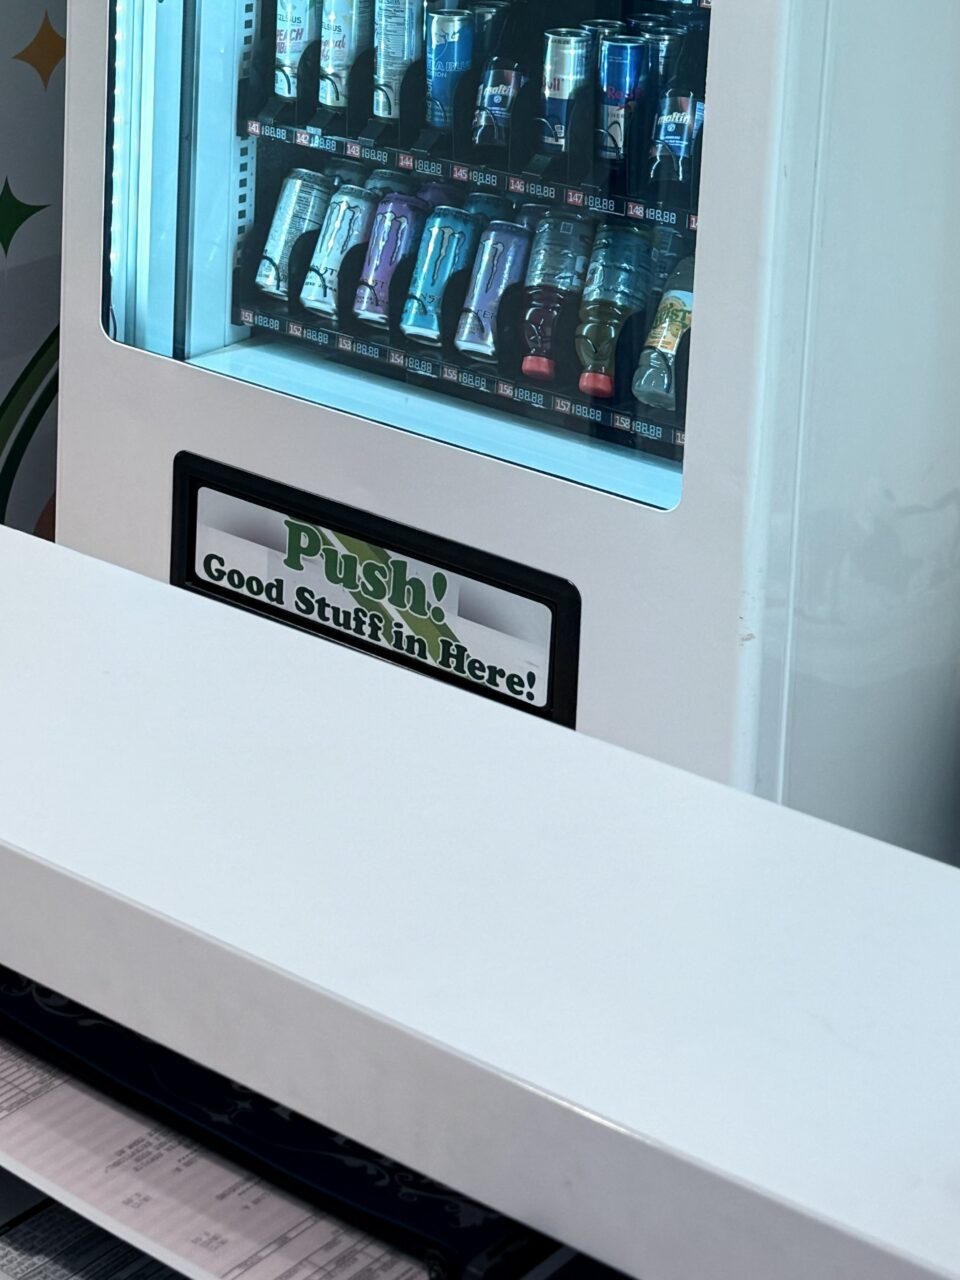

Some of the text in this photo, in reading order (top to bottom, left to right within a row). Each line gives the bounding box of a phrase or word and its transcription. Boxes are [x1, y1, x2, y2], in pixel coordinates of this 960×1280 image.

[248, 122, 260, 134] 141
[297, 133, 310, 144] 142
[347, 144, 360, 156] 143
[400, 155, 412, 167] 144
[454, 168, 468, 180] 145
[510, 178, 524, 191] 146
[568, 192, 583, 204] 147
[628, 204, 644, 216] 148
[241, 312, 253, 323] 151
[290, 324, 302, 336] 152
[340, 336, 352, 348] 153
[390, 352, 404, 365] 154
[444, 369, 457, 381] 155
[498, 384, 512, 396] 156
[556, 401, 570, 413] 157
[616, 416, 630, 428] 158
[283, 519, 448, 624] Push!
[202, 553, 536, 702] Good Stuff in Here!
